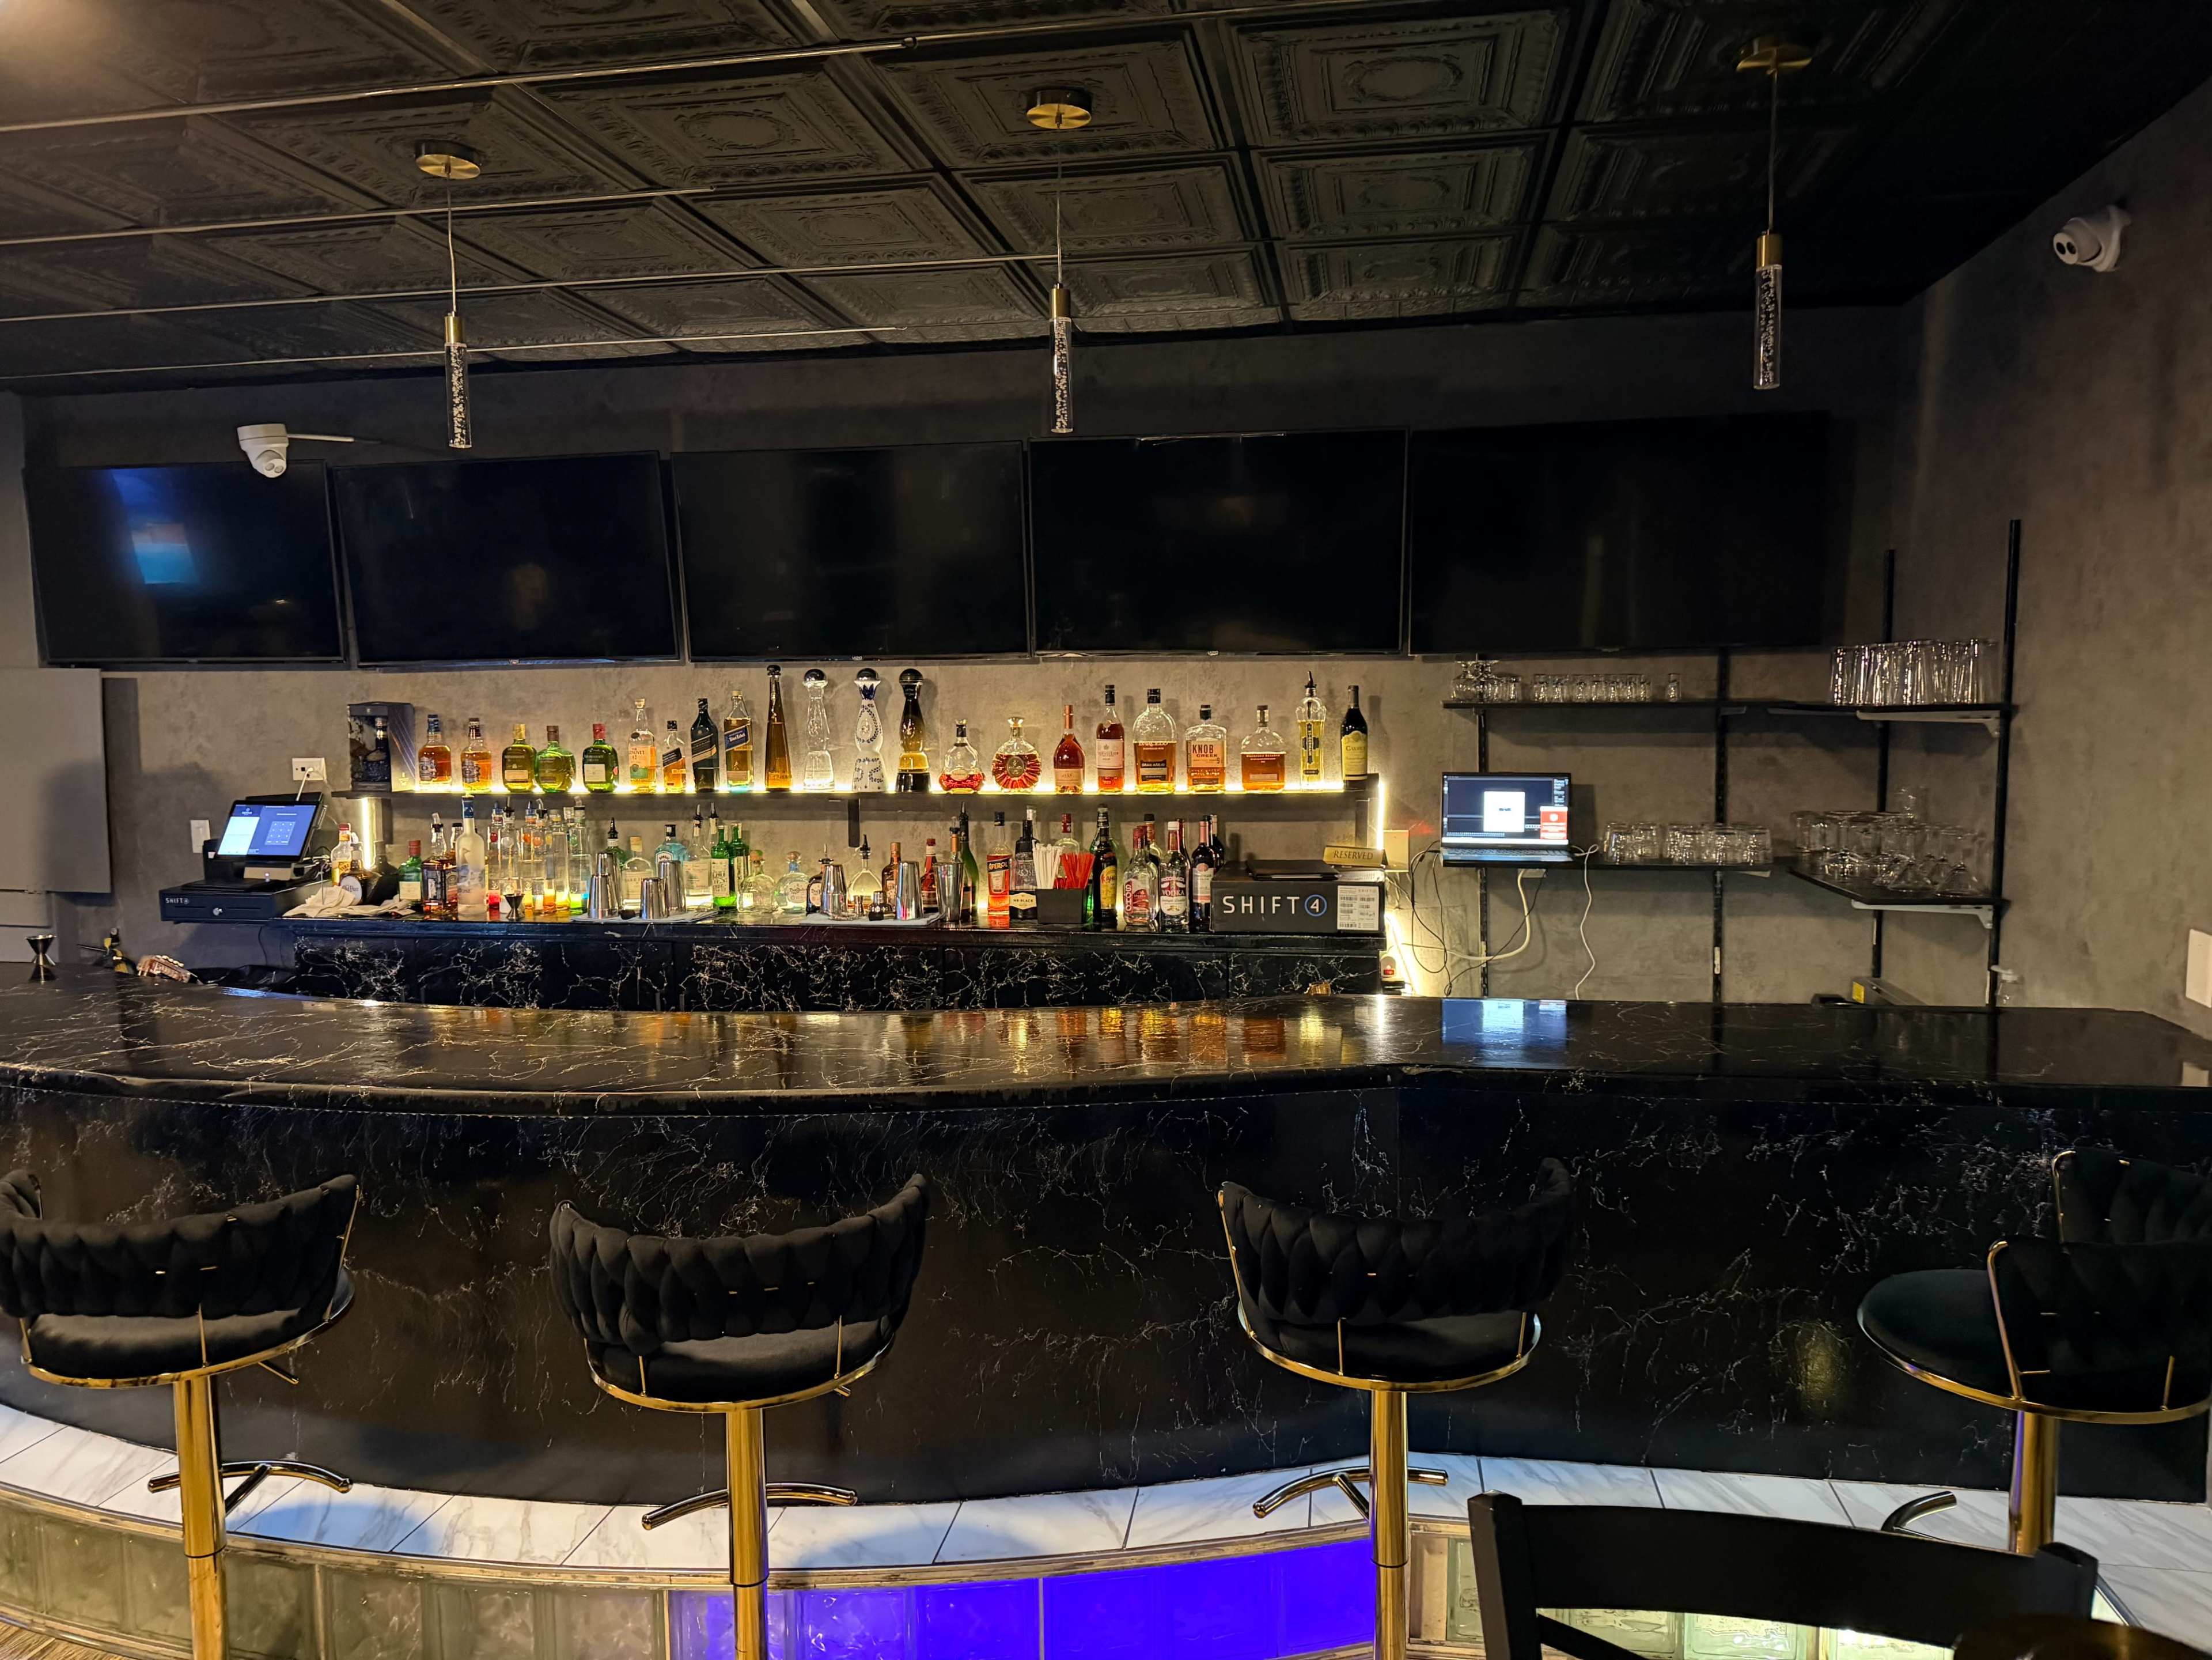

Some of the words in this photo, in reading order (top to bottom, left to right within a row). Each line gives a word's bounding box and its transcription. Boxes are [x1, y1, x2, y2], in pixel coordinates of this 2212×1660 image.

[1192, 744, 1214, 754] KNOB
[1333, 850, 1373, 860] RESERVED
[988, 862, 1008, 871] APEROL
[1222, 895, 1300, 915] SHIFT
